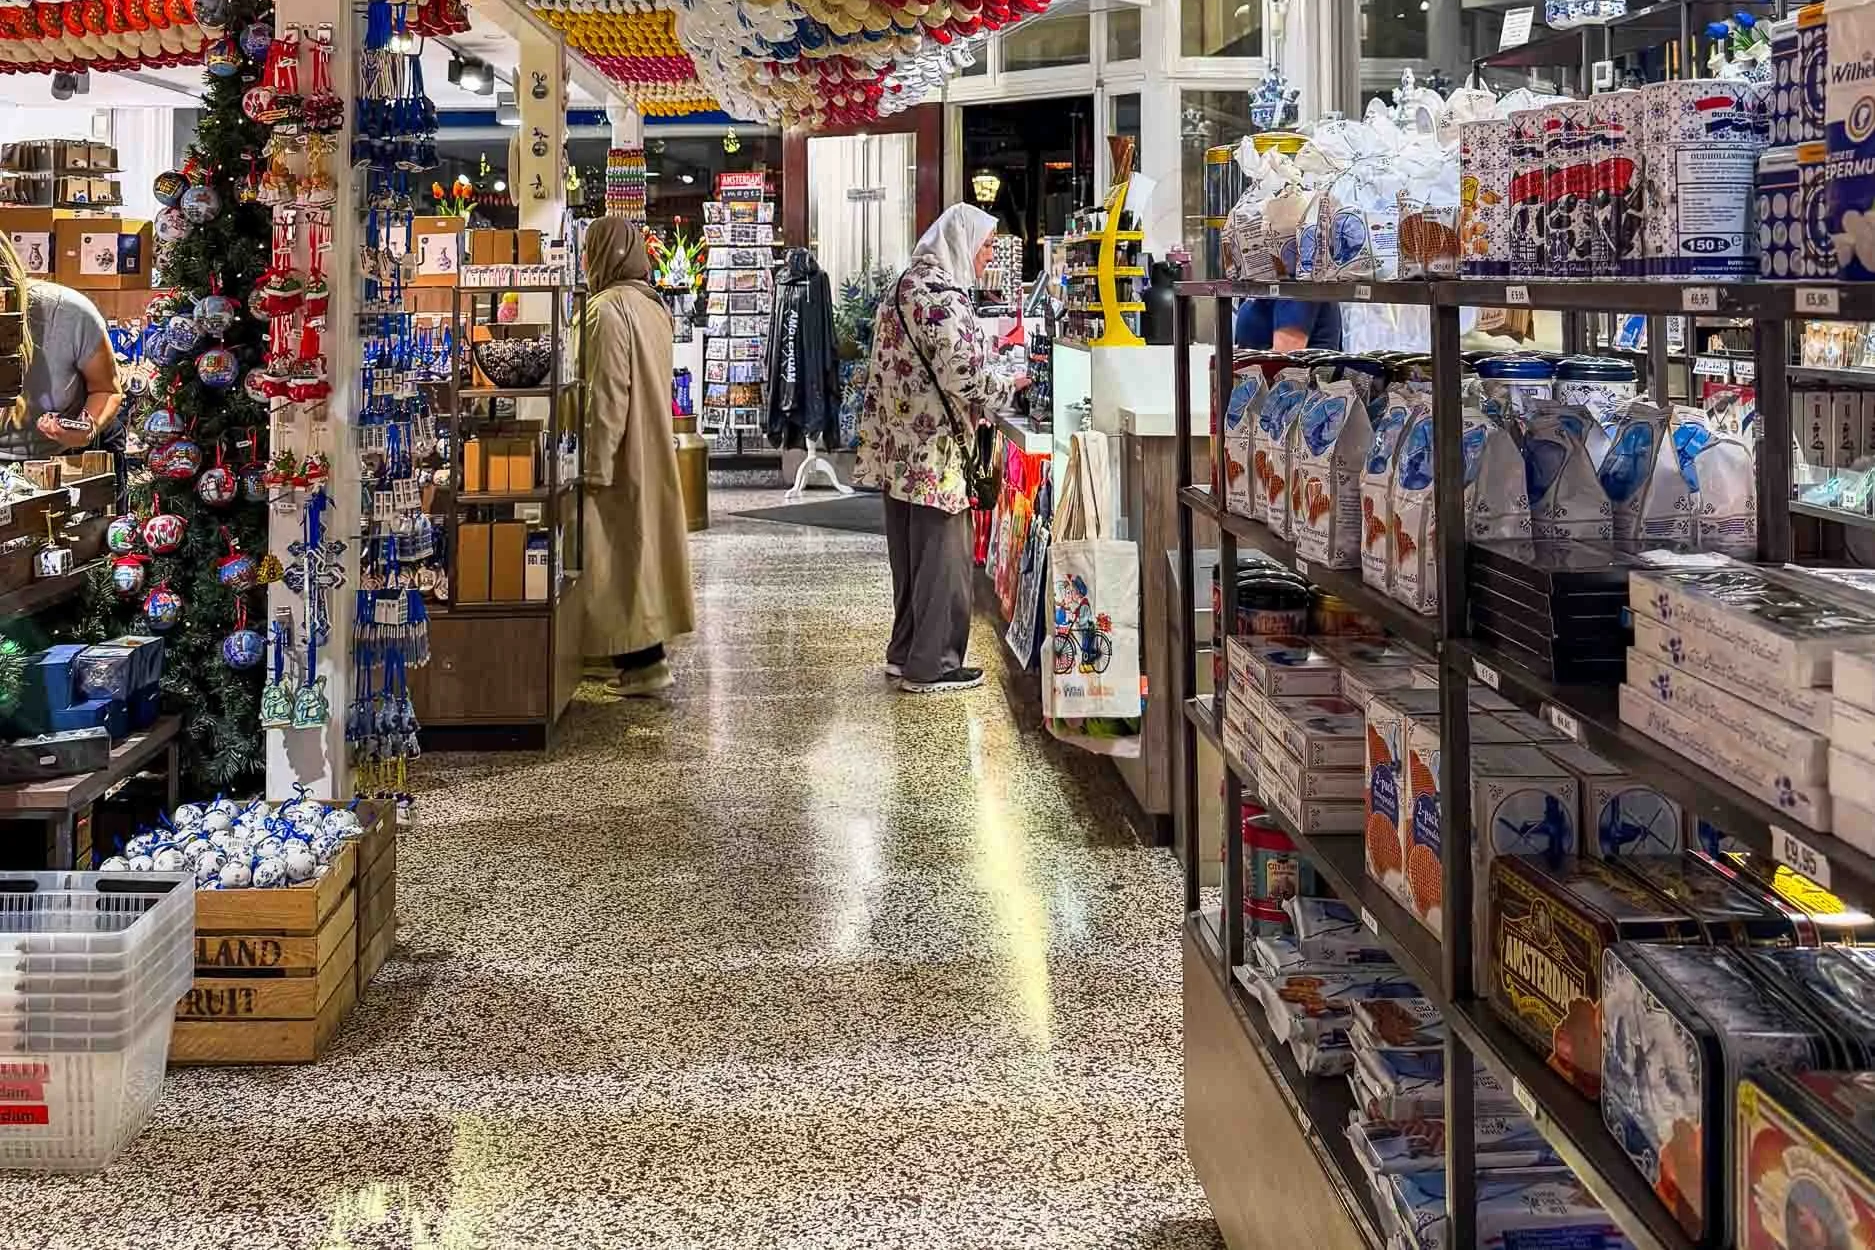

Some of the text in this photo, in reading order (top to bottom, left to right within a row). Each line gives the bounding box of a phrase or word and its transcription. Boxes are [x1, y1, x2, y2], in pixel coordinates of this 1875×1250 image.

[720, 173, 761, 185] AMSTERDAM
[1687, 239, 1715, 251] 150
[194, 938, 281, 966] LAND
